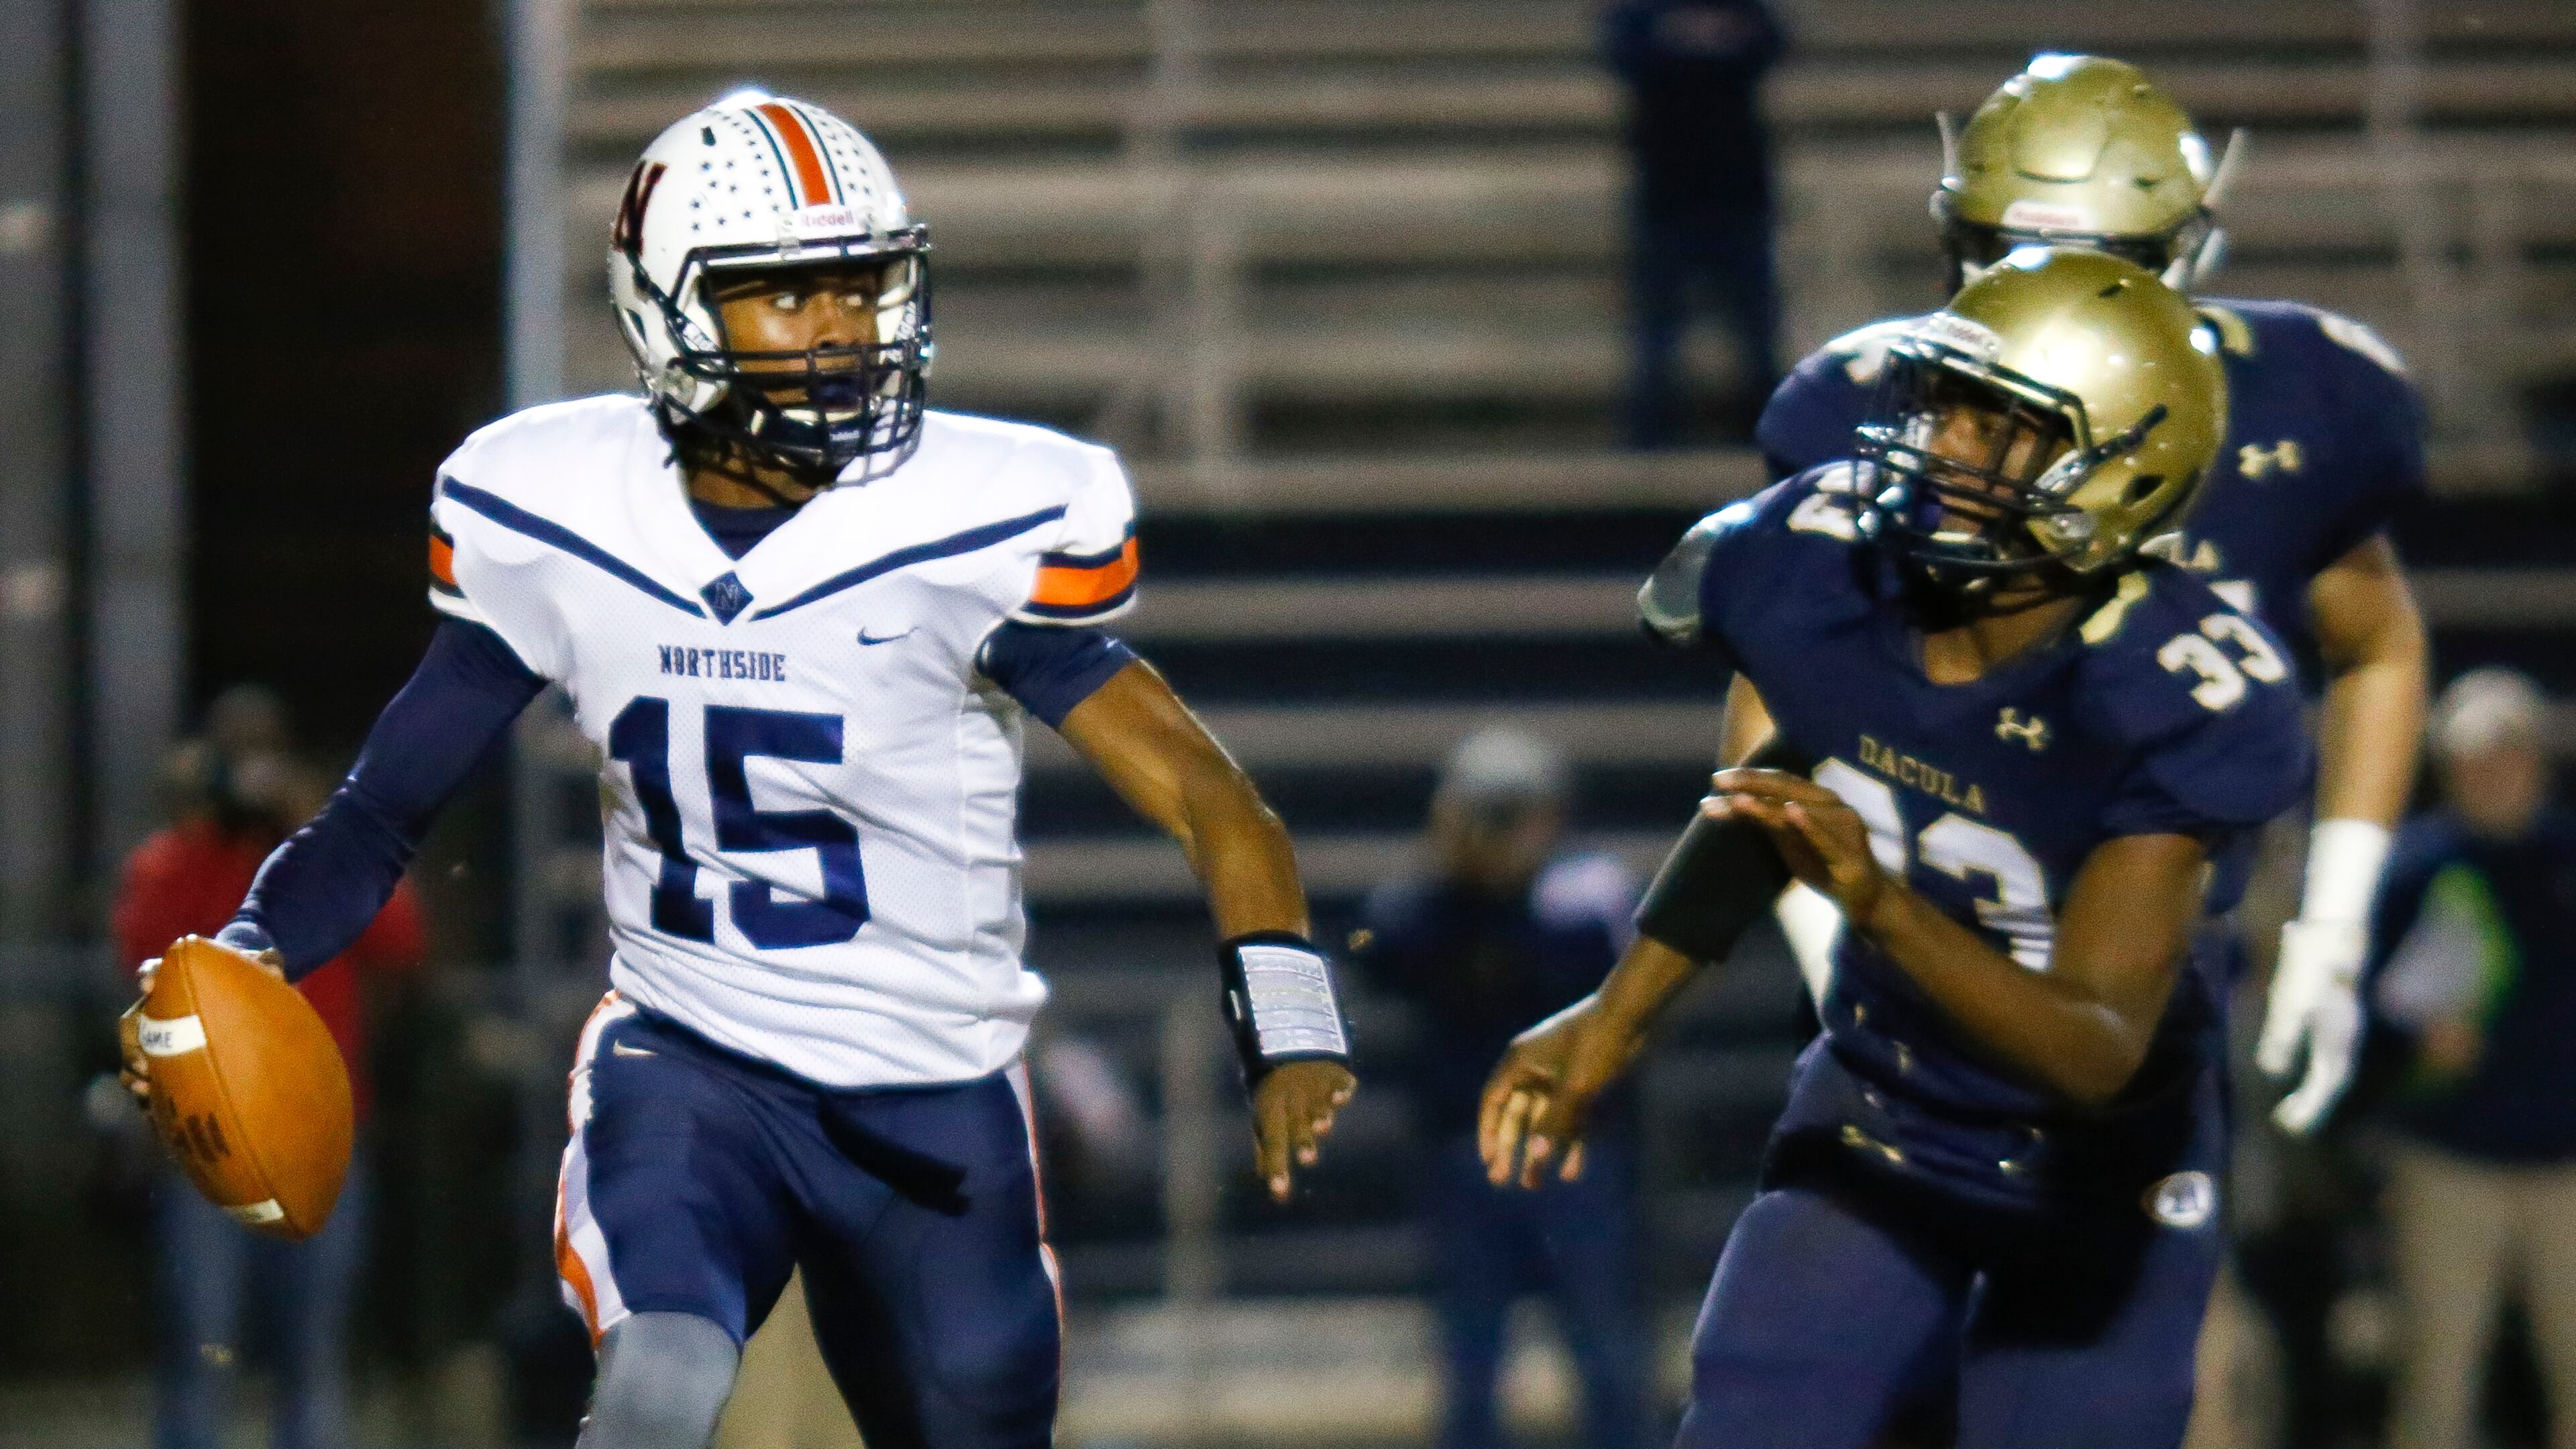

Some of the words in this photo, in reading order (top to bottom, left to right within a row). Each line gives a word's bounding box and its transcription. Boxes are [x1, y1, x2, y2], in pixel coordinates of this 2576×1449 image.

[657, 644, 786, 682] NORTHSIDE
[2157, 613, 2285, 710] 33
[1859, 735, 1986, 814] DACULA
[608, 695, 870, 950] 15
